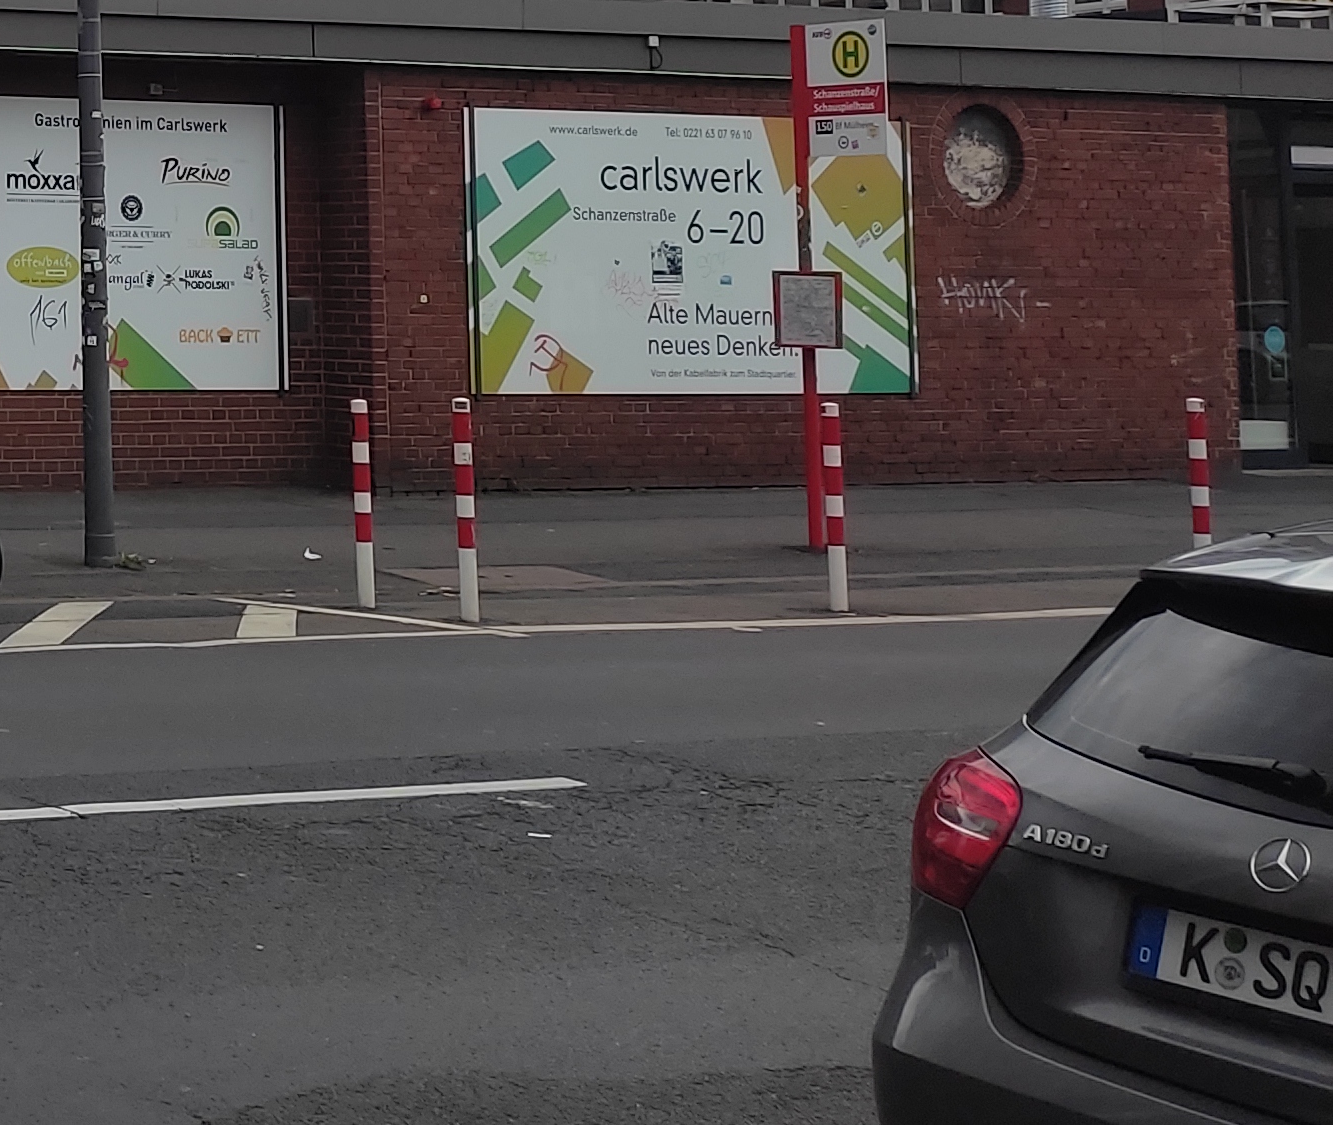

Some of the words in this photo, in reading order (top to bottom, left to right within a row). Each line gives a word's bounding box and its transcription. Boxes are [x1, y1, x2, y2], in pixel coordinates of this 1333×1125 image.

[841, 39, 860, 69] H
[136, 115, 153, 131] im
[156, 117, 228, 133] Carlswerk
[548, 125, 638, 137] www.carlswerk.de
[683, 127, 703, 139] 0221
[705, 128, 716, 139] 63
[717, 128, 728, 139] 07
[730, 129, 741, 140] 96
[743, 129, 753, 140] 10
[816, 121, 833, 132] 150
[600, 155, 764, 194] carlswerk
[572, 206, 677, 223] Schanzenstraße
[184, 269, 213, 279] LUKAS
[184, 280, 231, 290] PODOLSKI
[647, 302, 689, 325] Alte
[695, 302, 773, 326] Mauern
[179, 328, 214, 344] BACK
[236, 328, 262, 345] ETT
[648, 338, 710, 356] neues
[650, 369, 667, 378] Von
[667, 369, 682, 378] der
[1138, 946, 1151, 963] D
[1179, 921, 1220, 984] K
[1252, 941, 1331, 1013] SQ
